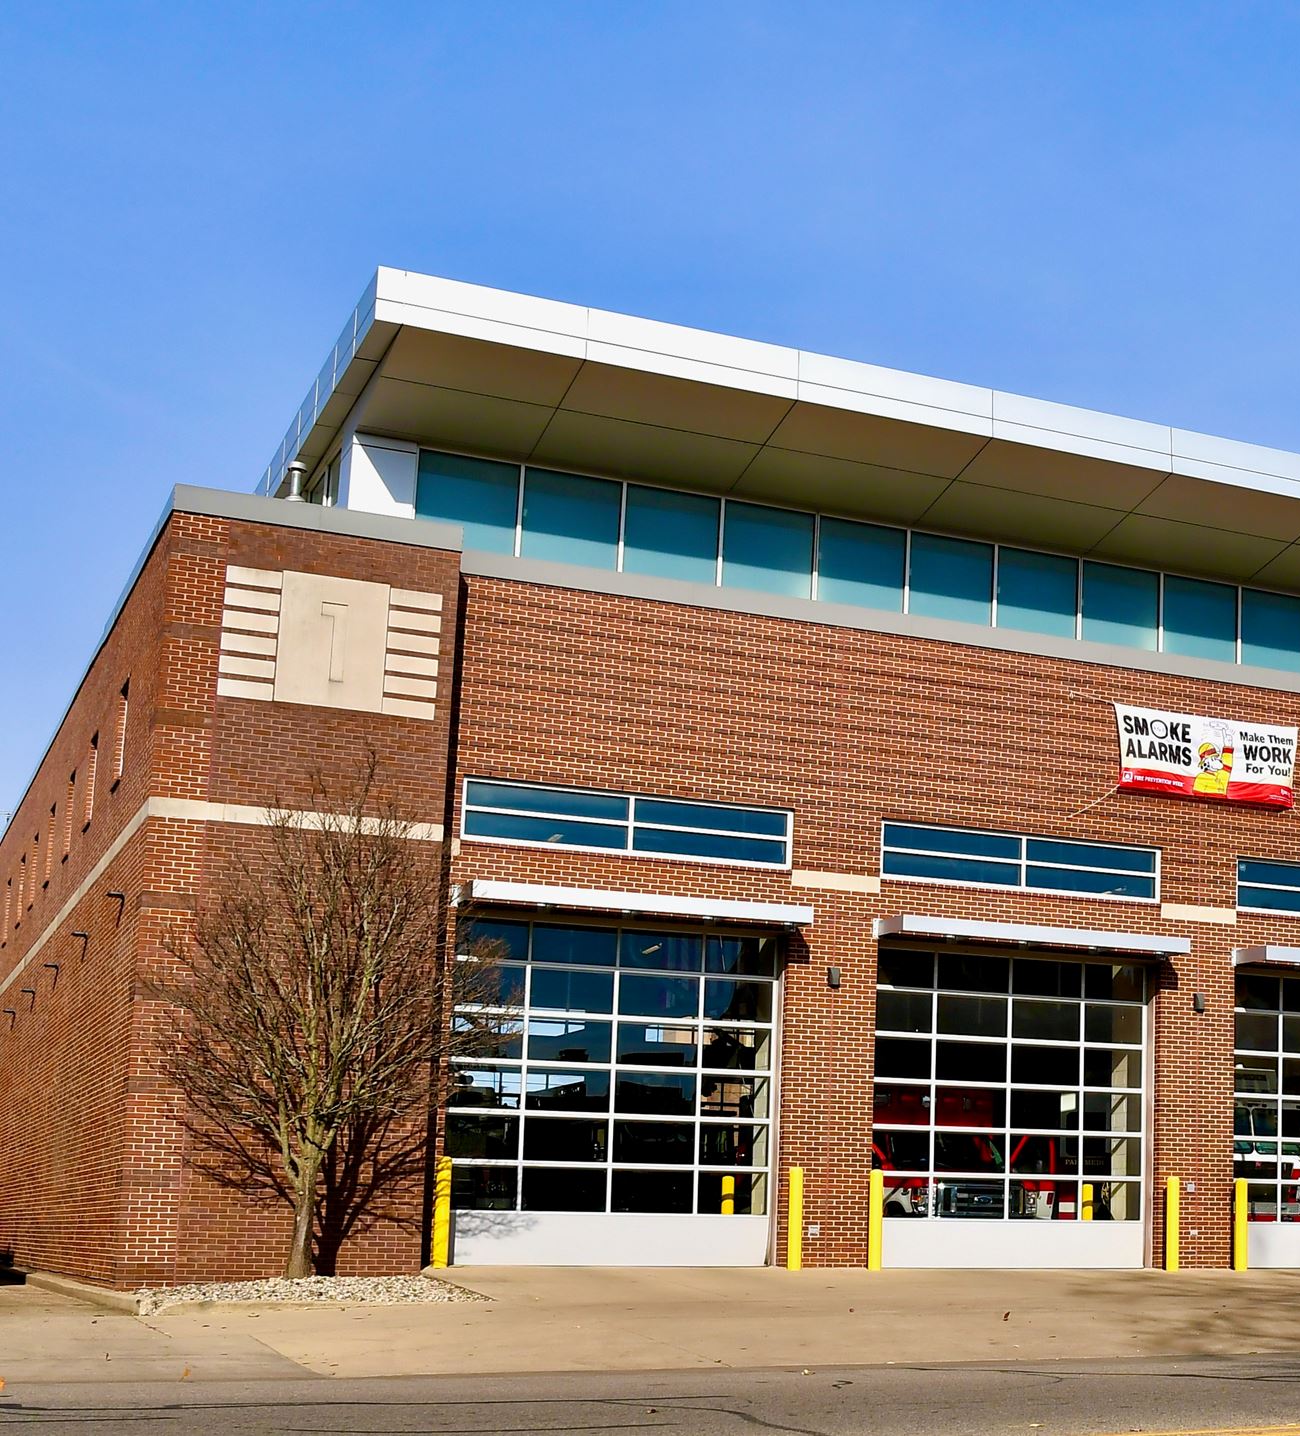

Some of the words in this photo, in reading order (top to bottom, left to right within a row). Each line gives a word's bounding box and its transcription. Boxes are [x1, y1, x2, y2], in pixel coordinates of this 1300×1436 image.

[1123, 714, 1192, 743] SMOKE
[1239, 731, 1265, 744] Make
[1267, 734, 1293, 746] Them
[1125, 738, 1192, 767] ALARMS
[1243, 744, 1292, 765] WORK
[1246, 763, 1263, 775] For
[1267, 765, 1291, 777] You!
